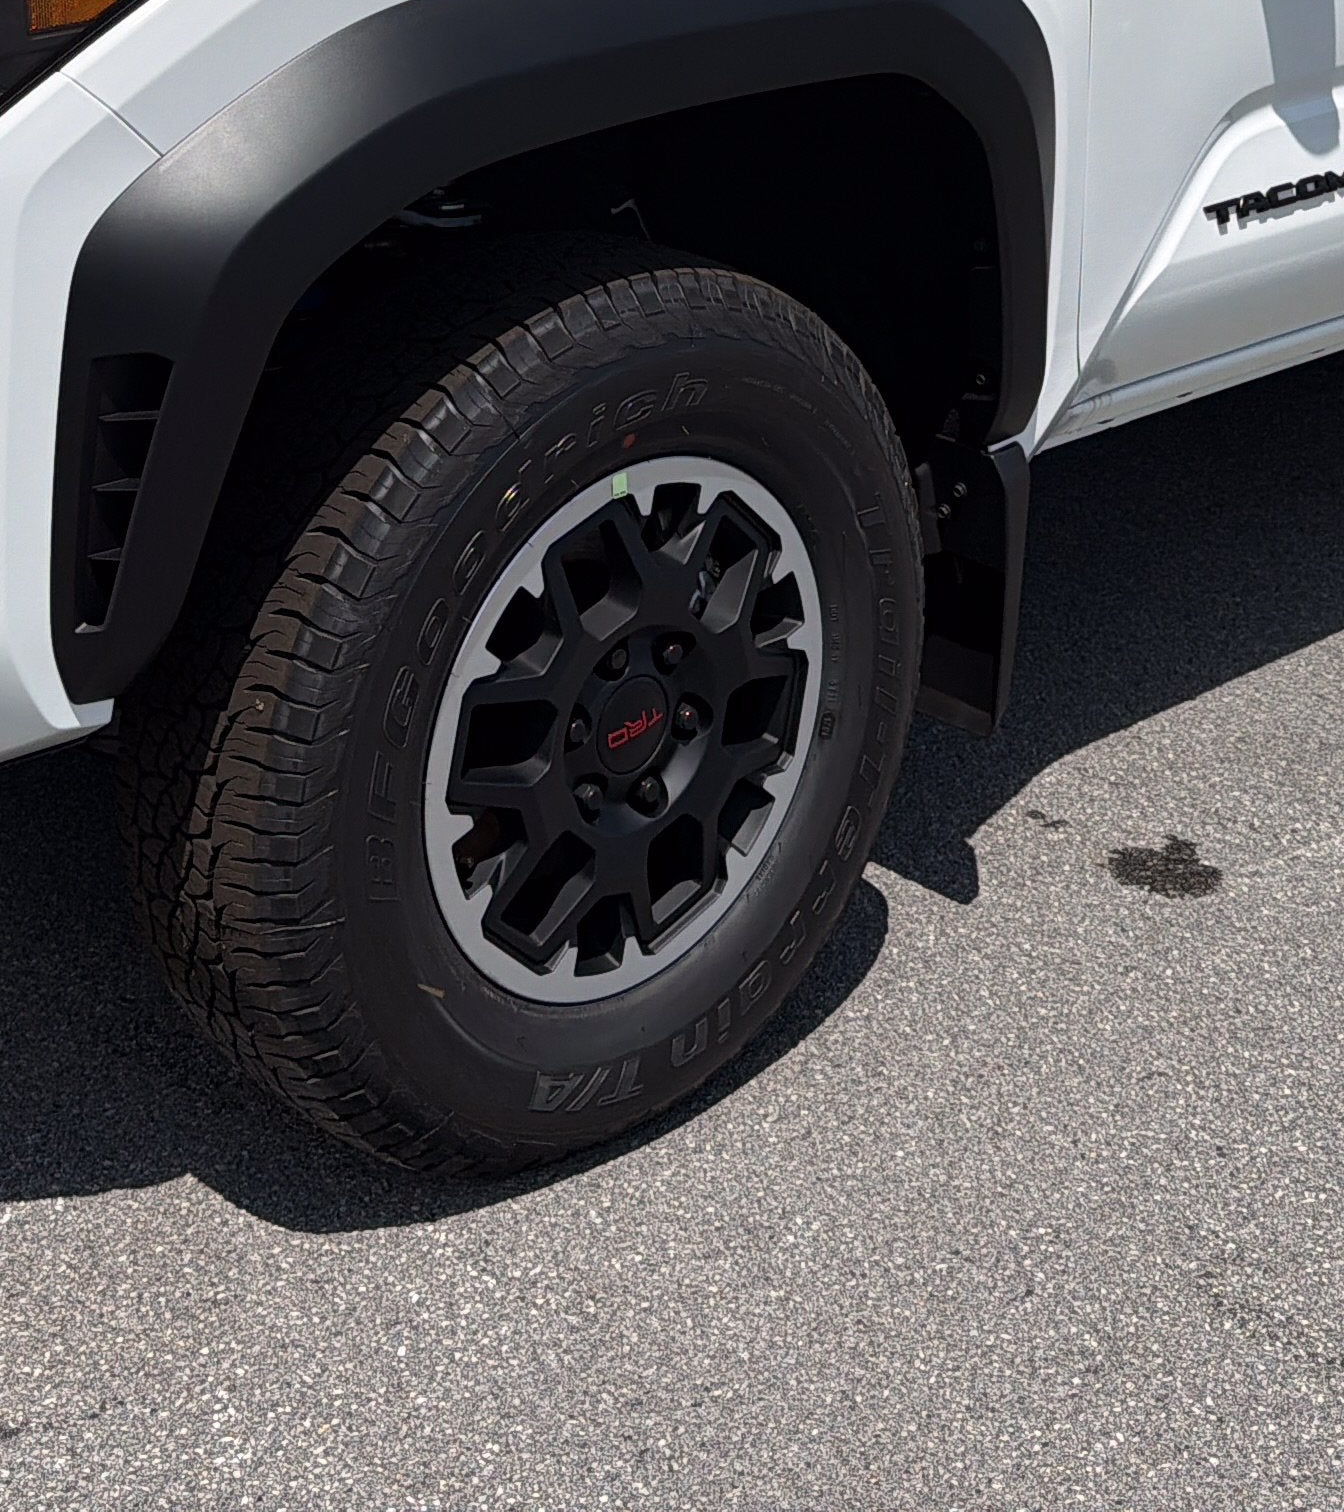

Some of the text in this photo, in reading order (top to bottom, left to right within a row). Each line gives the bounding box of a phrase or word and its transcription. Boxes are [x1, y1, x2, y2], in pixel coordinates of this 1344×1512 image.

[367, 370, 709, 904] BFGoodrich
[607, 707, 665, 750] TRD
[529, 1055, 645, 1113] T/A
